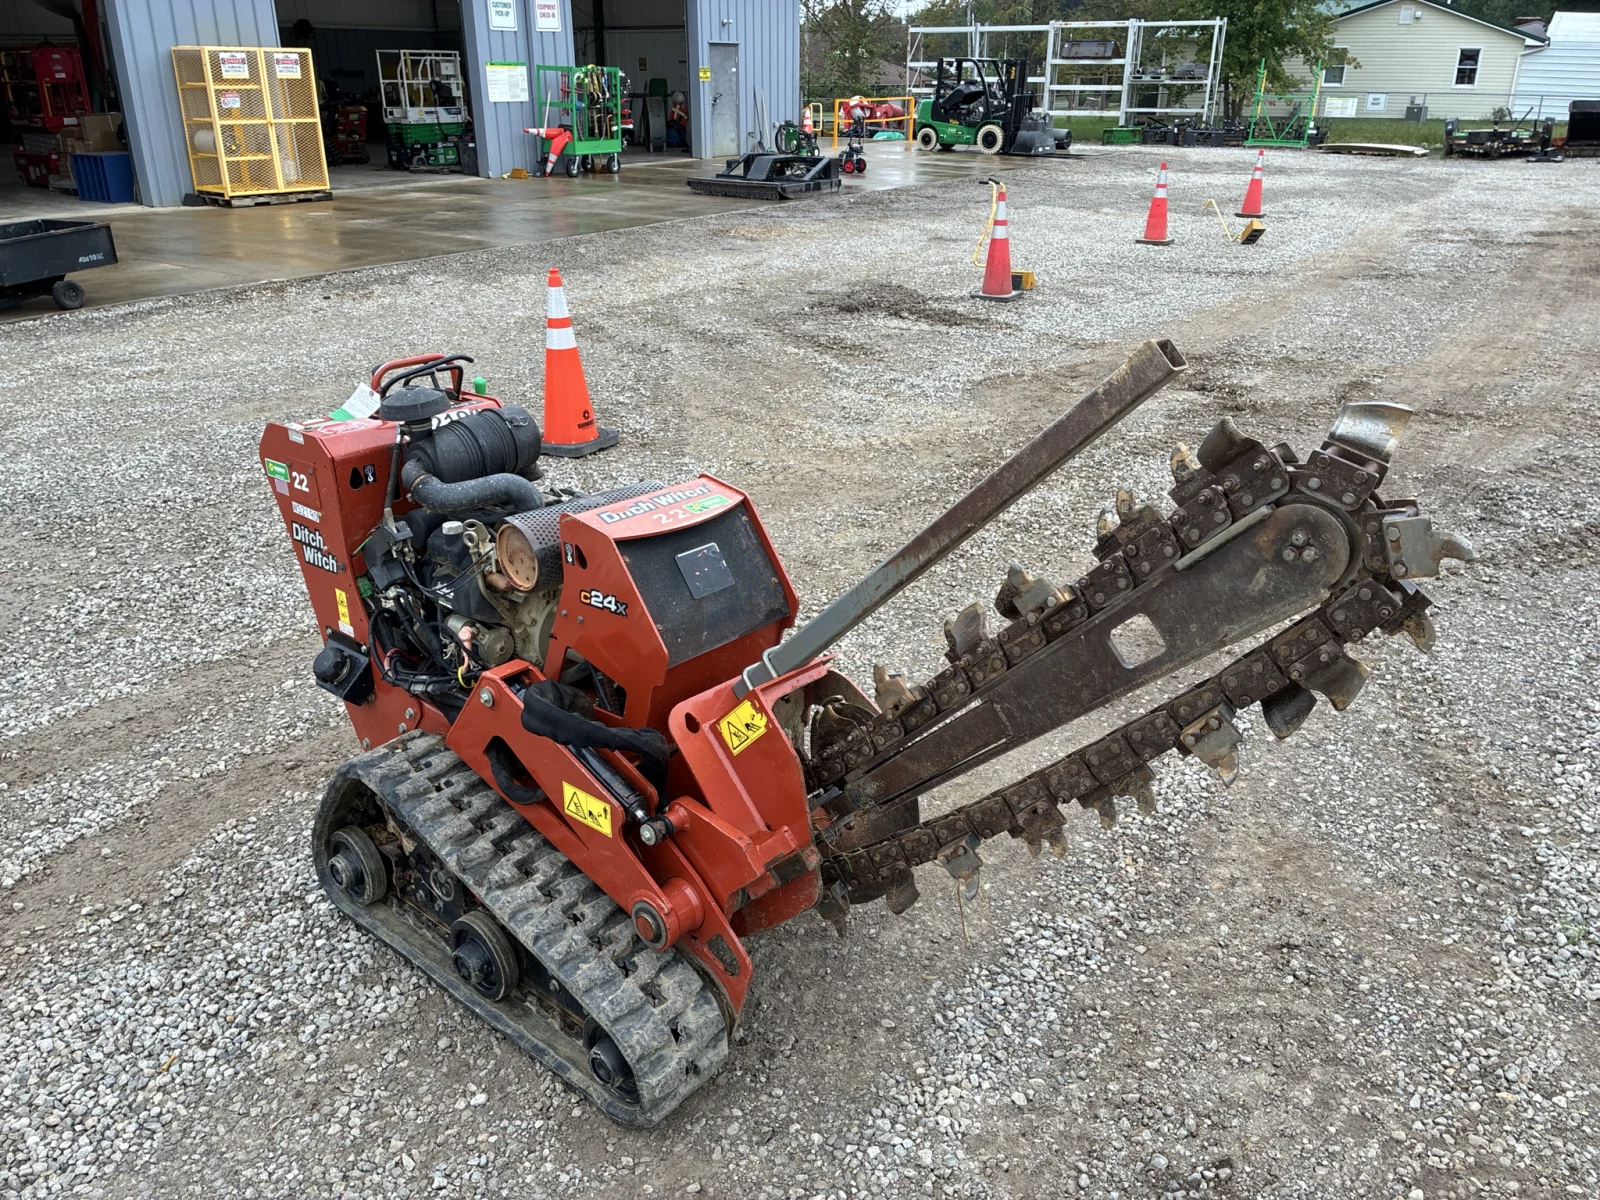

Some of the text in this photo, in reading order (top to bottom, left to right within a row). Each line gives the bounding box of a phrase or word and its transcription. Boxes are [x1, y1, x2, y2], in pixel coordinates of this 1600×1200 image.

[292, 471, 310, 493] 22
[598, 501, 656, 524] Ditch
[652, 484, 712, 507] Witch
[652, 508, 691, 525] 22
[292, 522, 324, 549] Ditch
[302, 544, 338, 573] Witch
